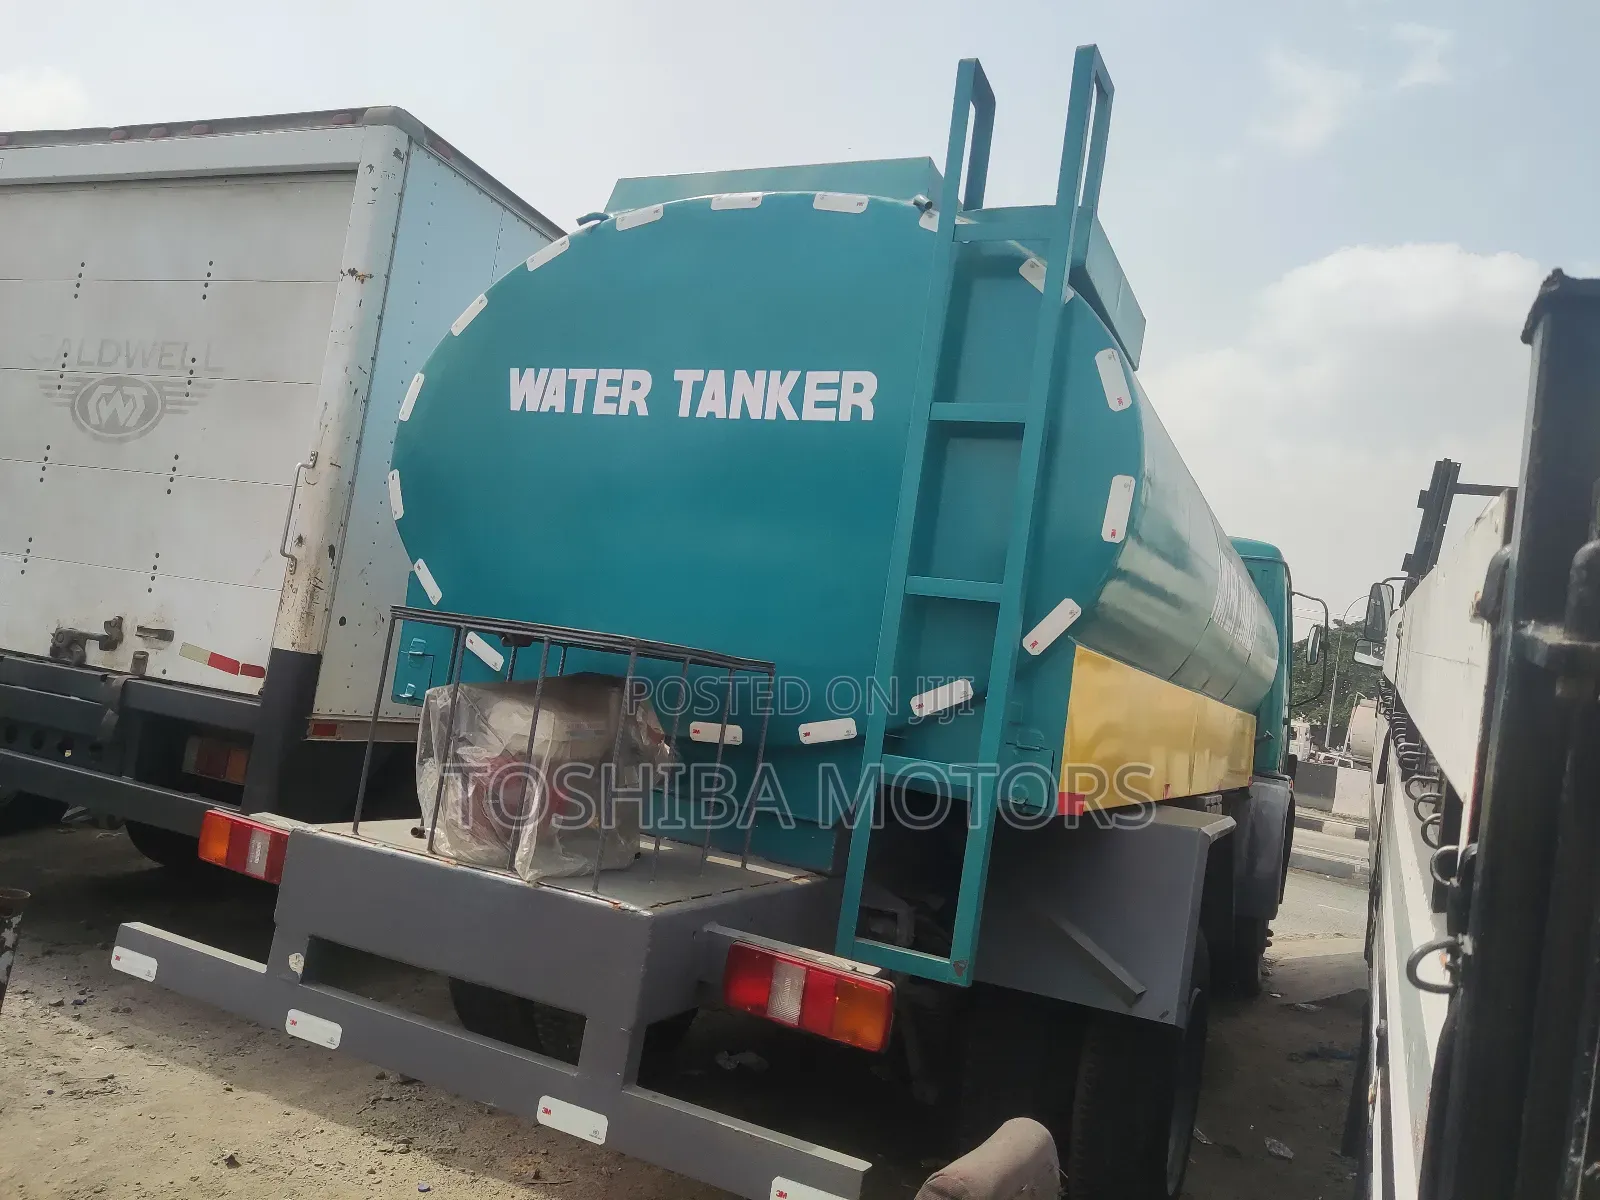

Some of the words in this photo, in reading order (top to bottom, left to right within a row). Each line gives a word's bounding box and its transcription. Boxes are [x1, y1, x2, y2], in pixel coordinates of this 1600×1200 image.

[510, 367, 653, 416] WATER
[674, 369, 878, 422] TANKER
[1030, 640, 1039, 650] 3M
[802, 730, 811, 738] 3M
[542, 1106, 552, 1116] 3M
[776, 1189, 788, 1200] 3M
